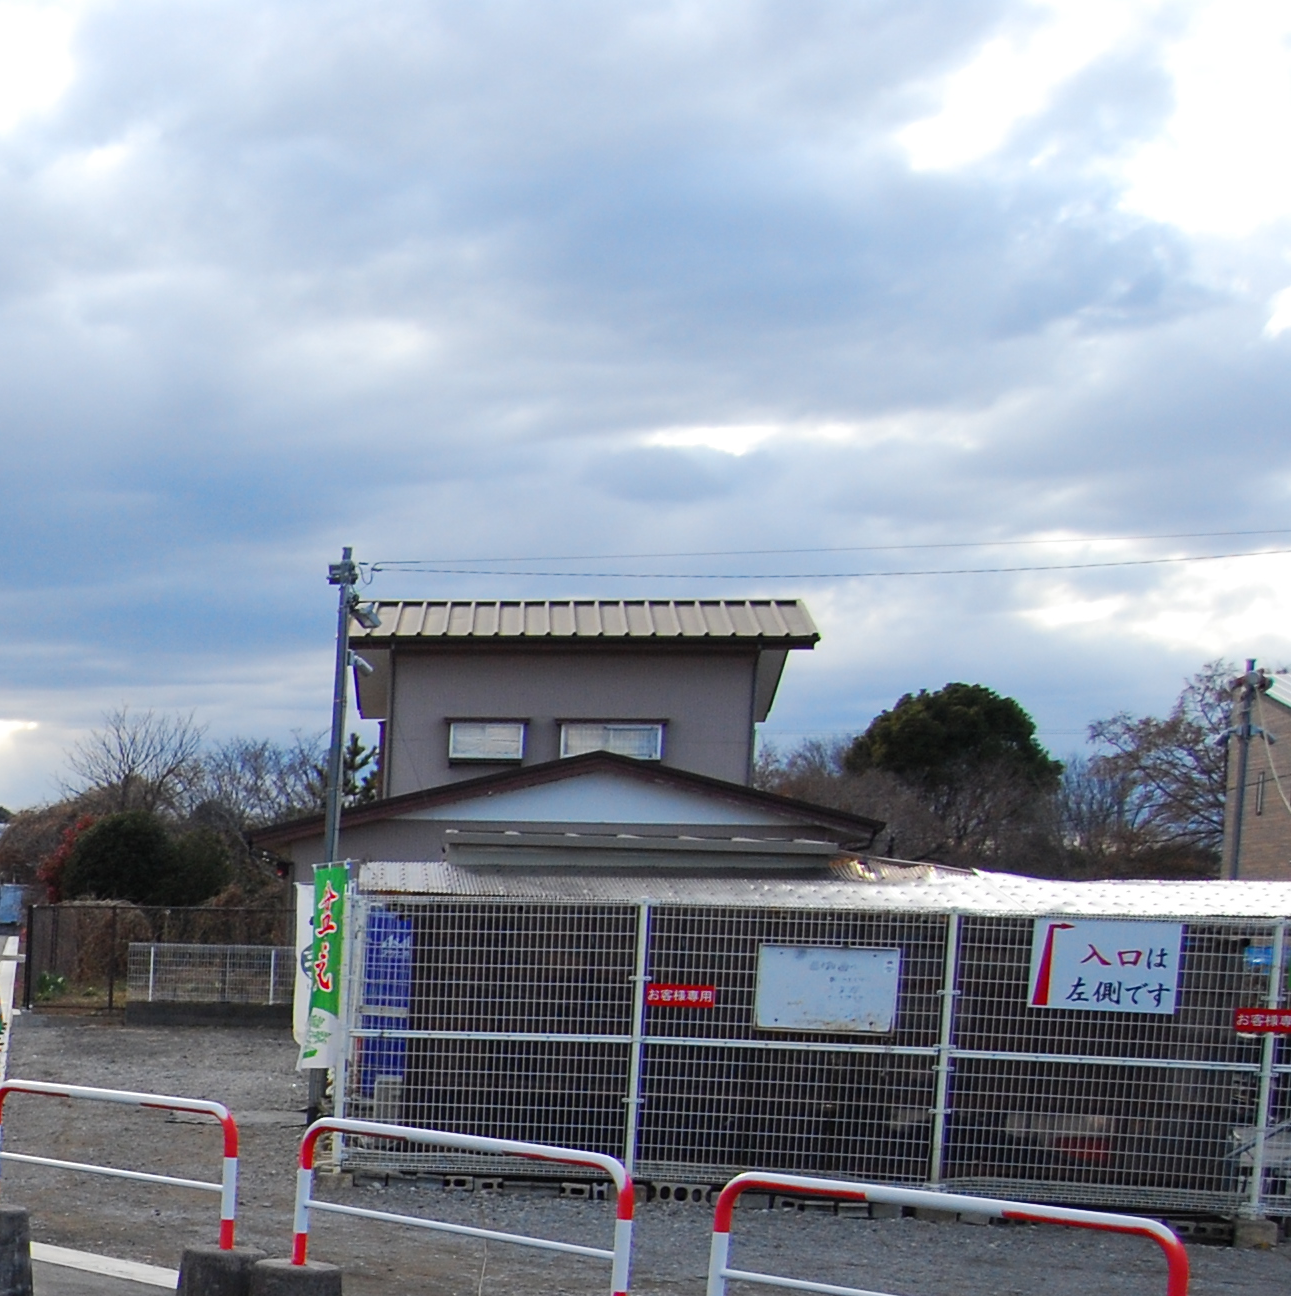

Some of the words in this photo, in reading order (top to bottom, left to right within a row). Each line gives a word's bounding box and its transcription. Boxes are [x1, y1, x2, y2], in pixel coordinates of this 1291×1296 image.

[1080, 943, 1168, 969] 入口は
[647, 989, 712, 1002] お客様専用
[1066, 977, 1170, 1008] 左側です
